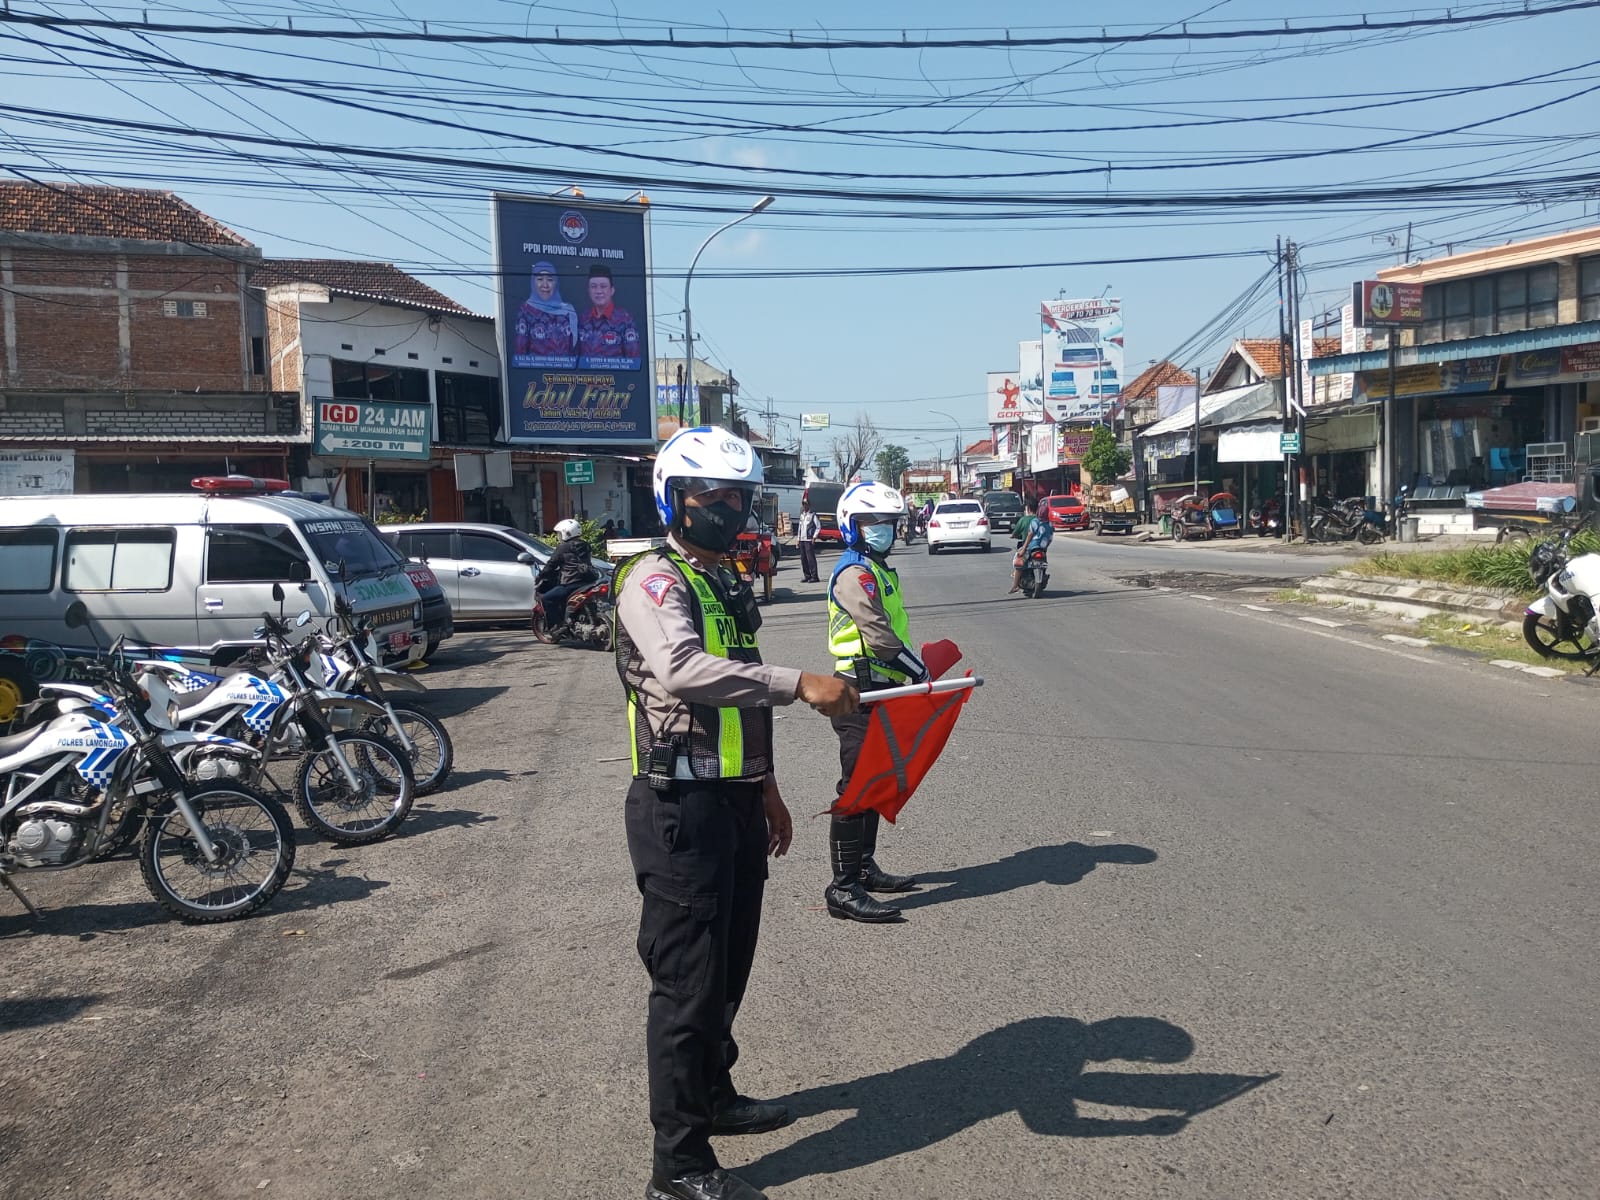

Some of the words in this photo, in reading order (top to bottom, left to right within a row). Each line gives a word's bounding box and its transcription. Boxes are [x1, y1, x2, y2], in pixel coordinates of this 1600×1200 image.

[523, 243, 541, 253] PPDI
[543, 244, 577, 256] PROVINSI
[579, 247, 600, 257] JAWA
[601, 248, 624, 259] TIMUR
[523, 382, 576, 409] Idul
[579, 383, 635, 409] Fitri
[322, 404, 358, 424] IGD
[365, 407, 386, 425] 24
[390, 408, 425, 428] JAM
[389, 441, 405, 450] M
[304, 521, 343, 534] INSANI
[57, 738, 83, 746] POLRES
[85, 739, 123, 748] LAMONGAN
